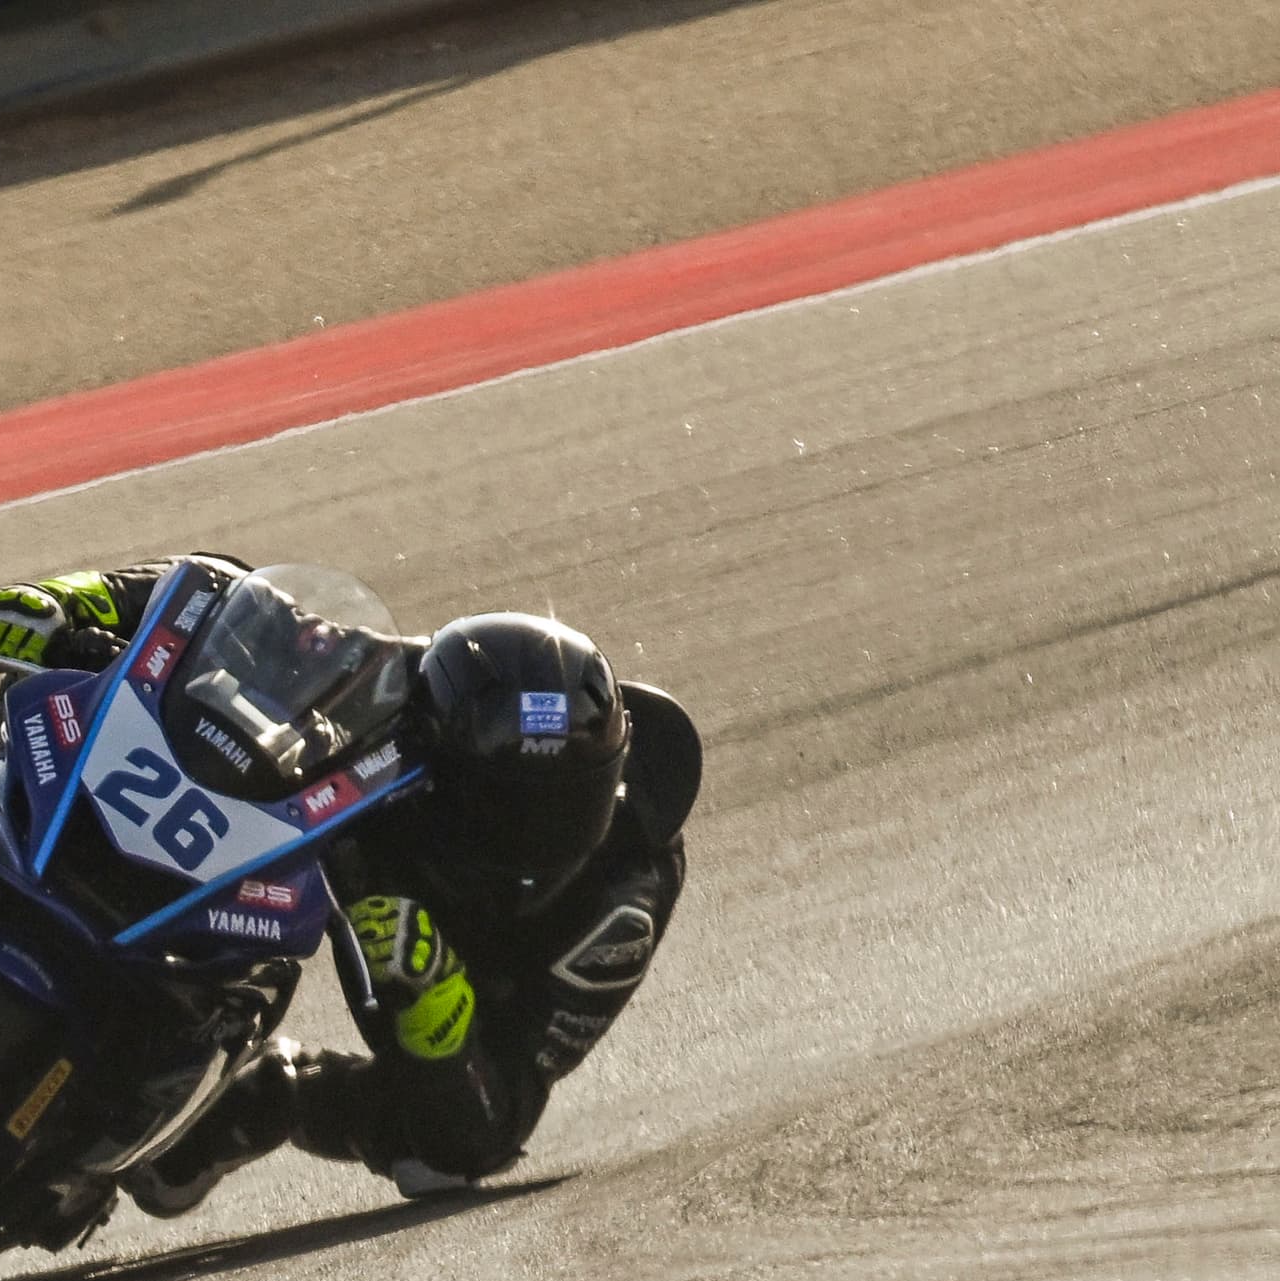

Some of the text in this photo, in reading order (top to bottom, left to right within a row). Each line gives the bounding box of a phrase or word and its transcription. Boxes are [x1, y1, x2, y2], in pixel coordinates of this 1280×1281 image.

[54, 694, 81, 743] BS
[193, 716, 253, 775] YAMAHA
[23, 713, 57, 786] YAMAHA
[93, 746, 229, 871] 26
[239, 880, 293, 904] BS
[207, 908, 282, 941] YAMAHA
